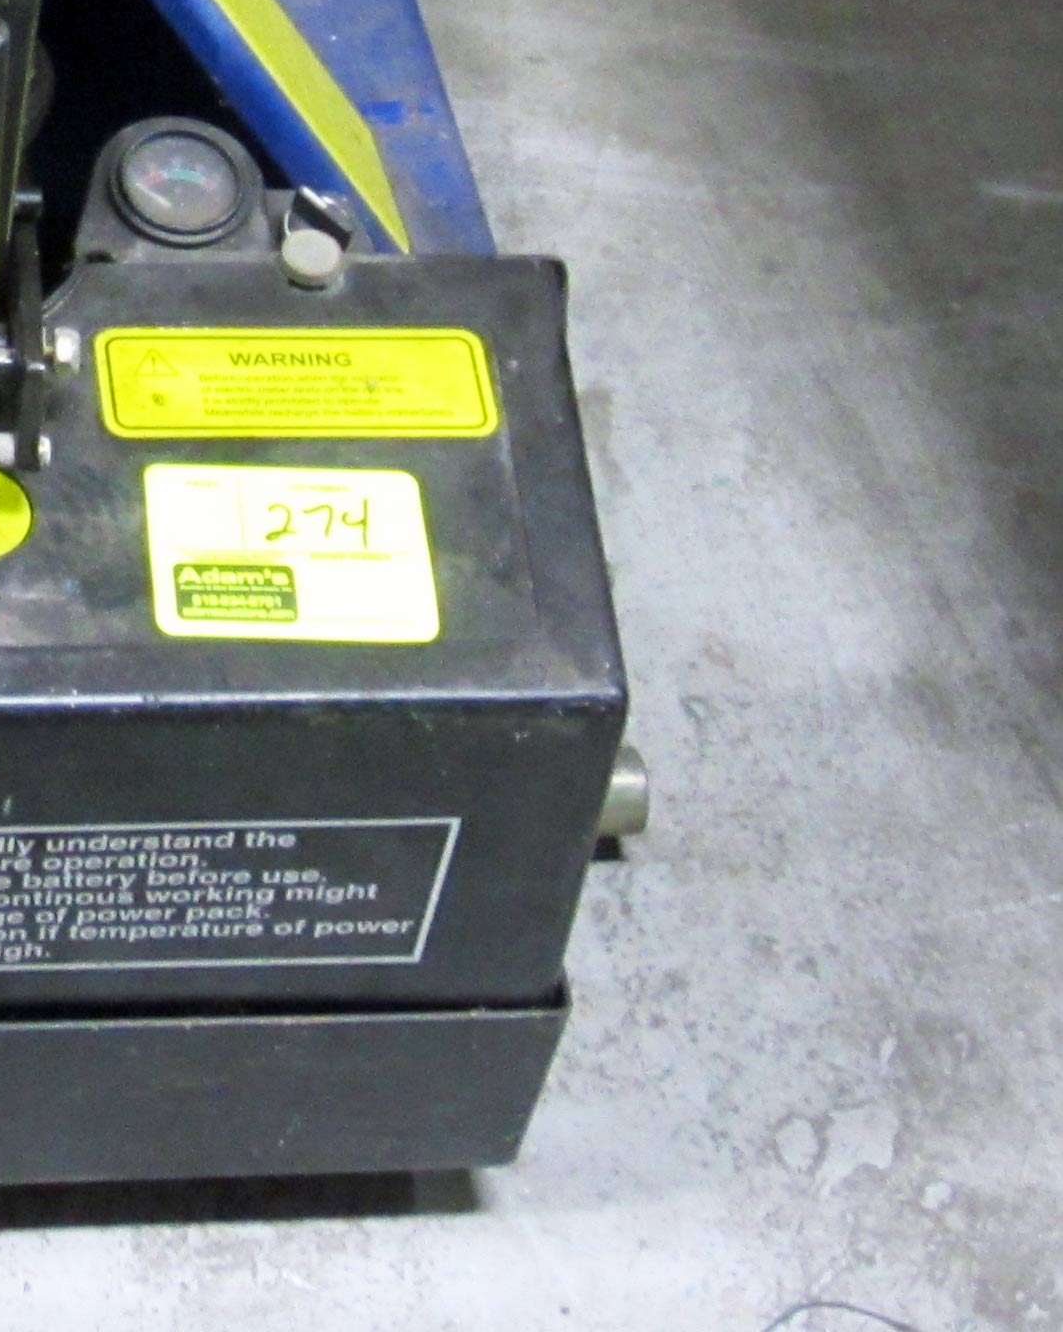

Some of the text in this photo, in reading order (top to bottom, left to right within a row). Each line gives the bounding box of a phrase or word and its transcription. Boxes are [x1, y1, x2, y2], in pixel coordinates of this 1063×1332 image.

[228, 352, 353, 367] WARNING
[264, 499, 371, 548] 274
[46, 831, 235, 854] understand
[245, 831, 296, 849] the
[42, 851, 209, 875] operation.
[22, 871, 136, 891] battery
[147, 869, 252, 886] before
[262, 869, 327, 885] use.
[145, 885, 275, 906] working
[285, 882, 379, 905] might
[35, 907, 68, 923] of
[77, 908, 177, 926] power
[186, 903, 271, 924] pack.
[37, 924, 60, 941] if
[69, 922, 263, 943] temperature
[274, 919, 306, 936] of
[314, 919, 415, 938] power
